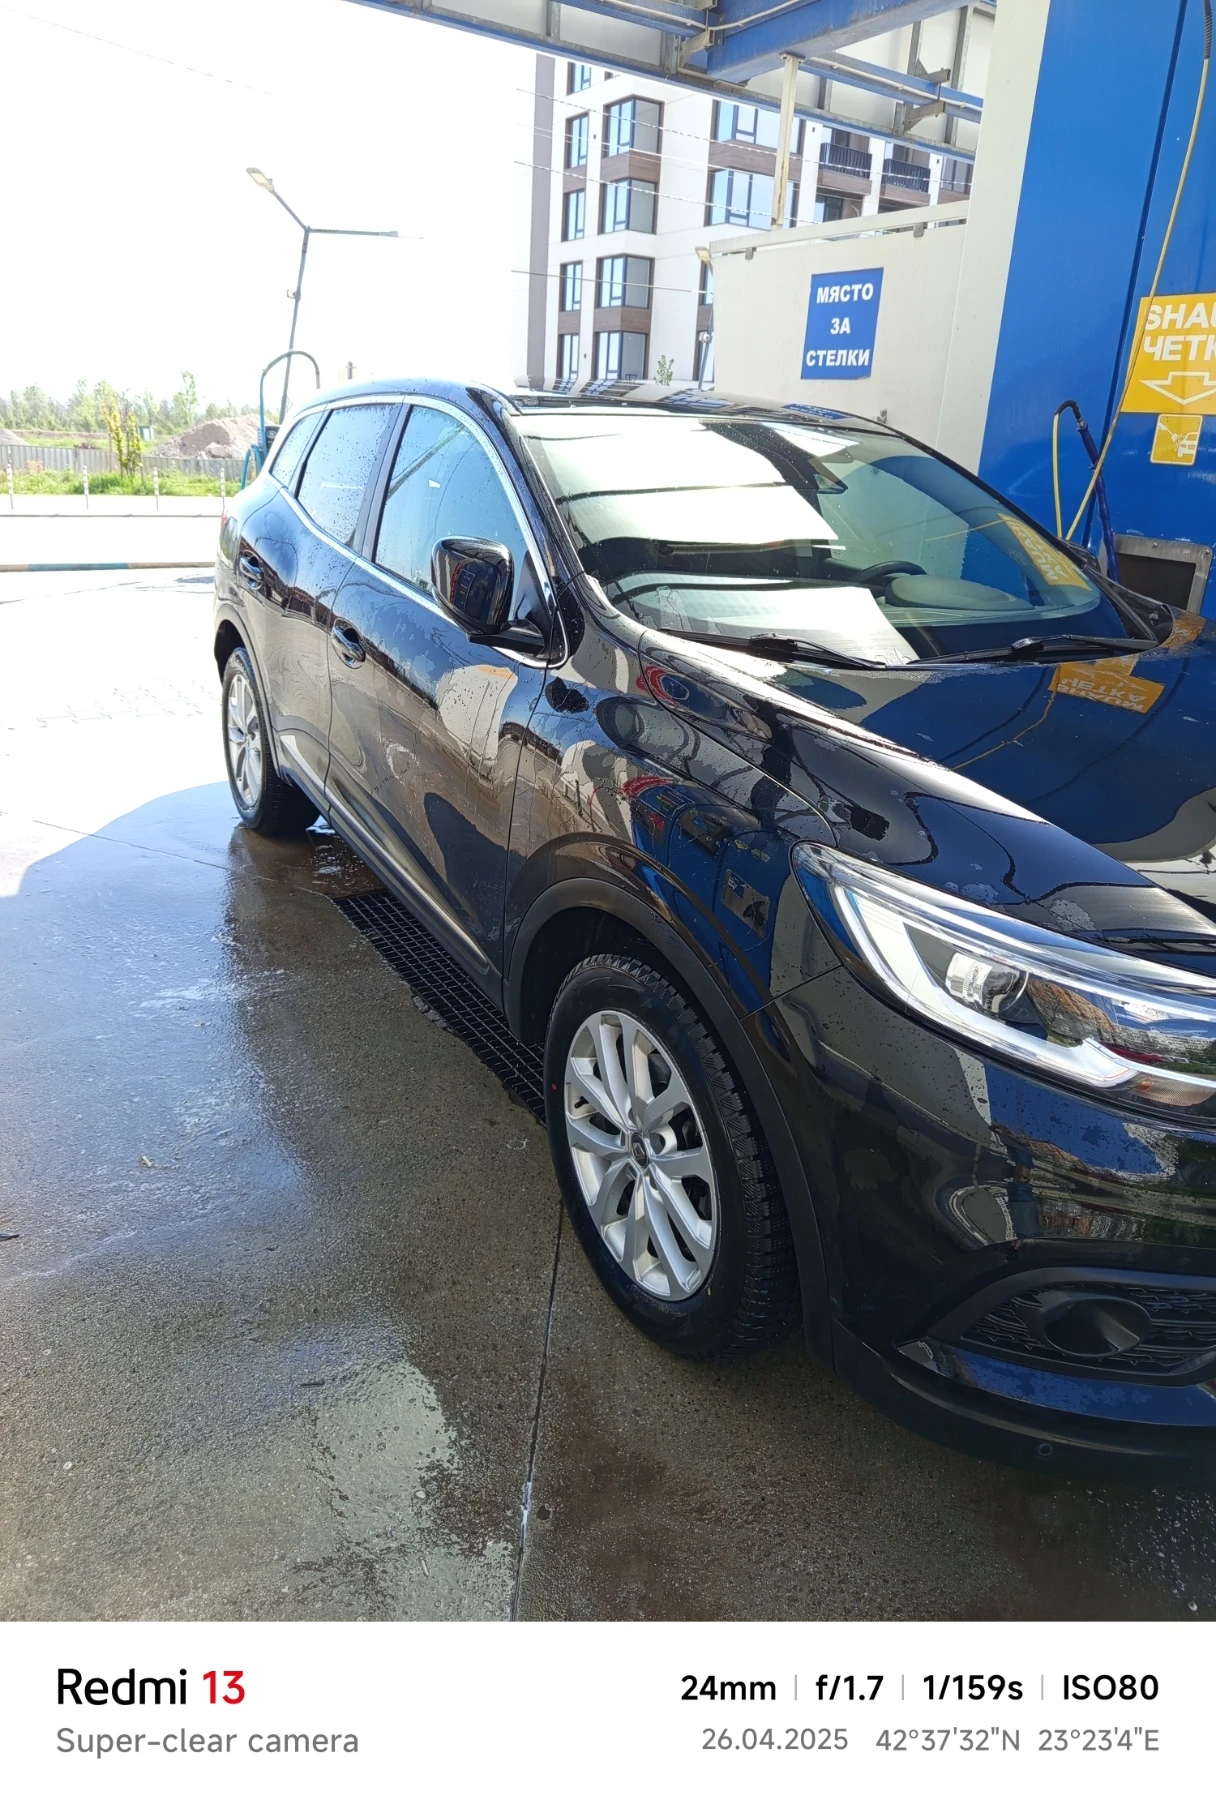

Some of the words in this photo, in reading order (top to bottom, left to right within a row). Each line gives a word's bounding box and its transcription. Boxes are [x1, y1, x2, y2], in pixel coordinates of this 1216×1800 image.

[817, 283, 873, 303] МЯСТО
[831, 318, 850, 334] ЗА
[806, 349, 870, 367] СТЕЛКИ
